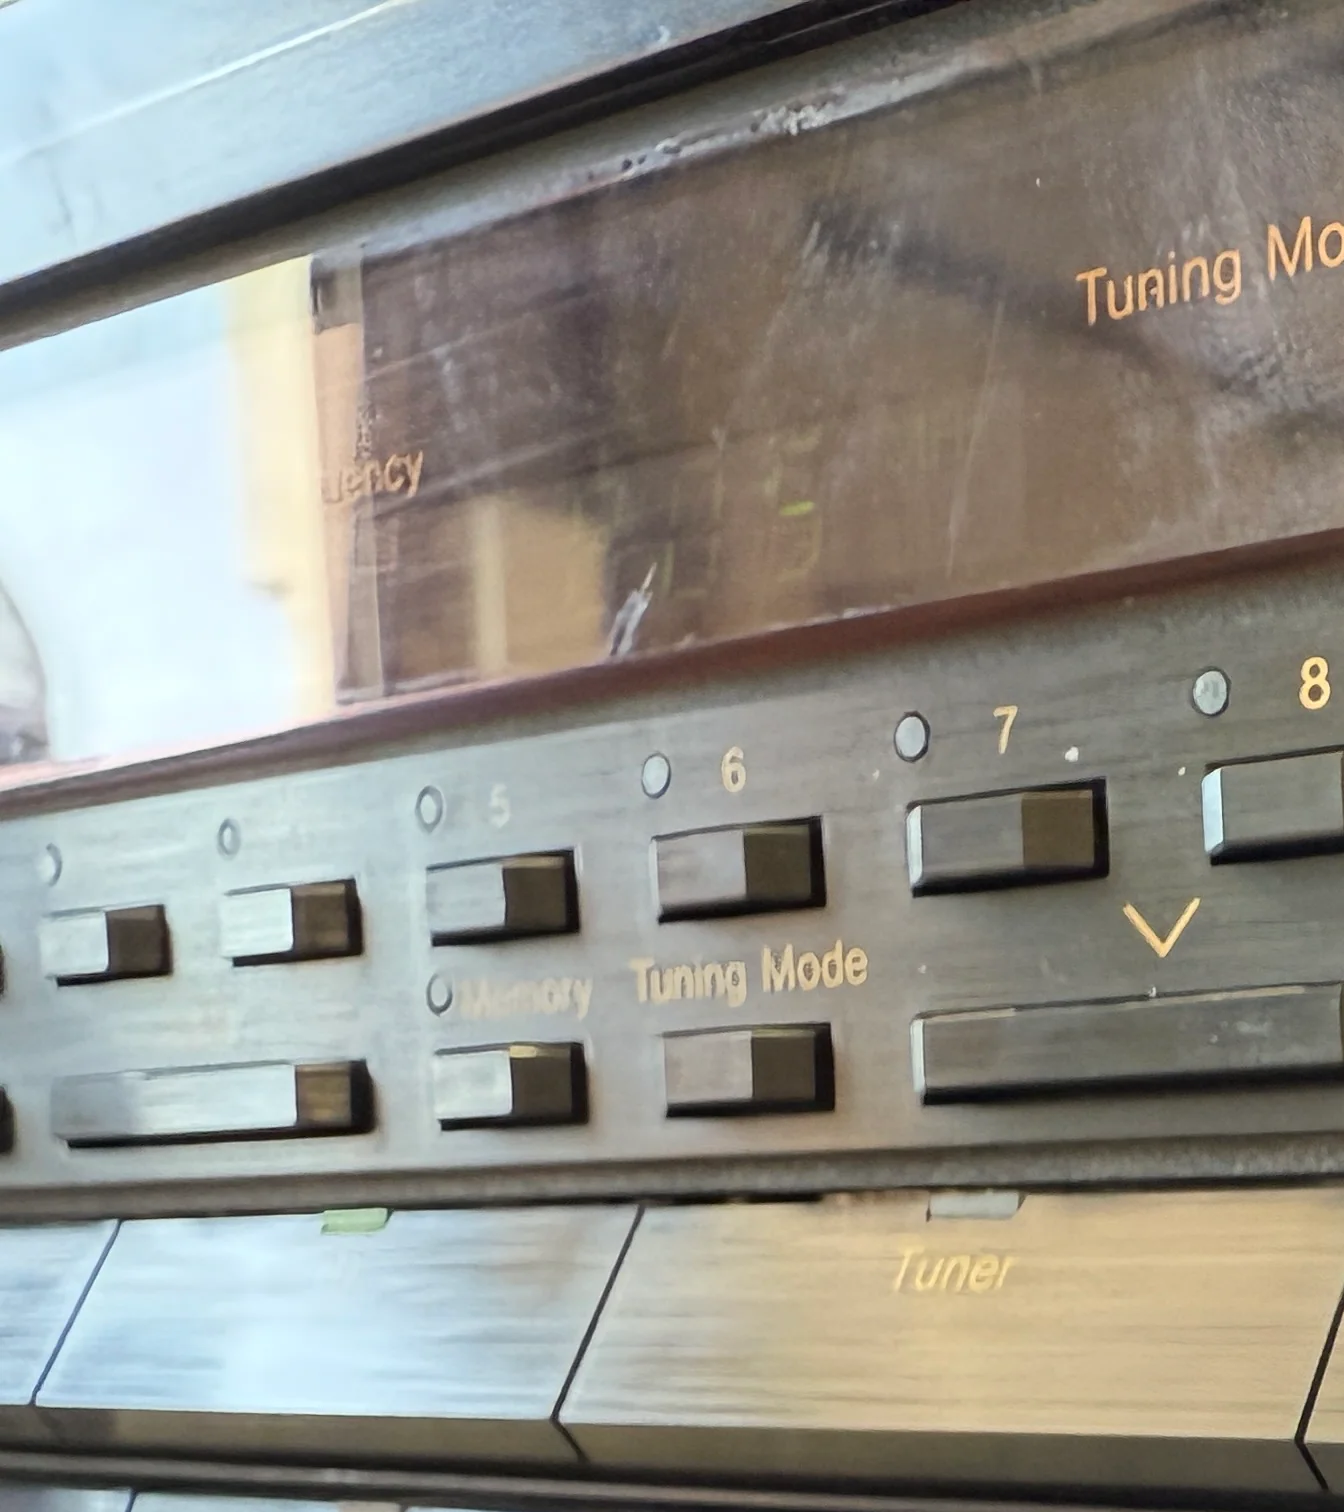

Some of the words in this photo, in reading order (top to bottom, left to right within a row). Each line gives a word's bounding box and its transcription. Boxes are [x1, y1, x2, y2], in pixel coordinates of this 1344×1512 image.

[1076, 242, 1243, 327] Tuning
[1298, 656, 1332, 711] 8
[992, 704, 1019, 755] 7
[720, 745, 748, 794] 6
[489, 783, 512, 829] 5
[629, 955, 748, 1008] Tuning
[761, 939, 870, 994] Mode
[894, 1235, 1020, 1294] Tuner
